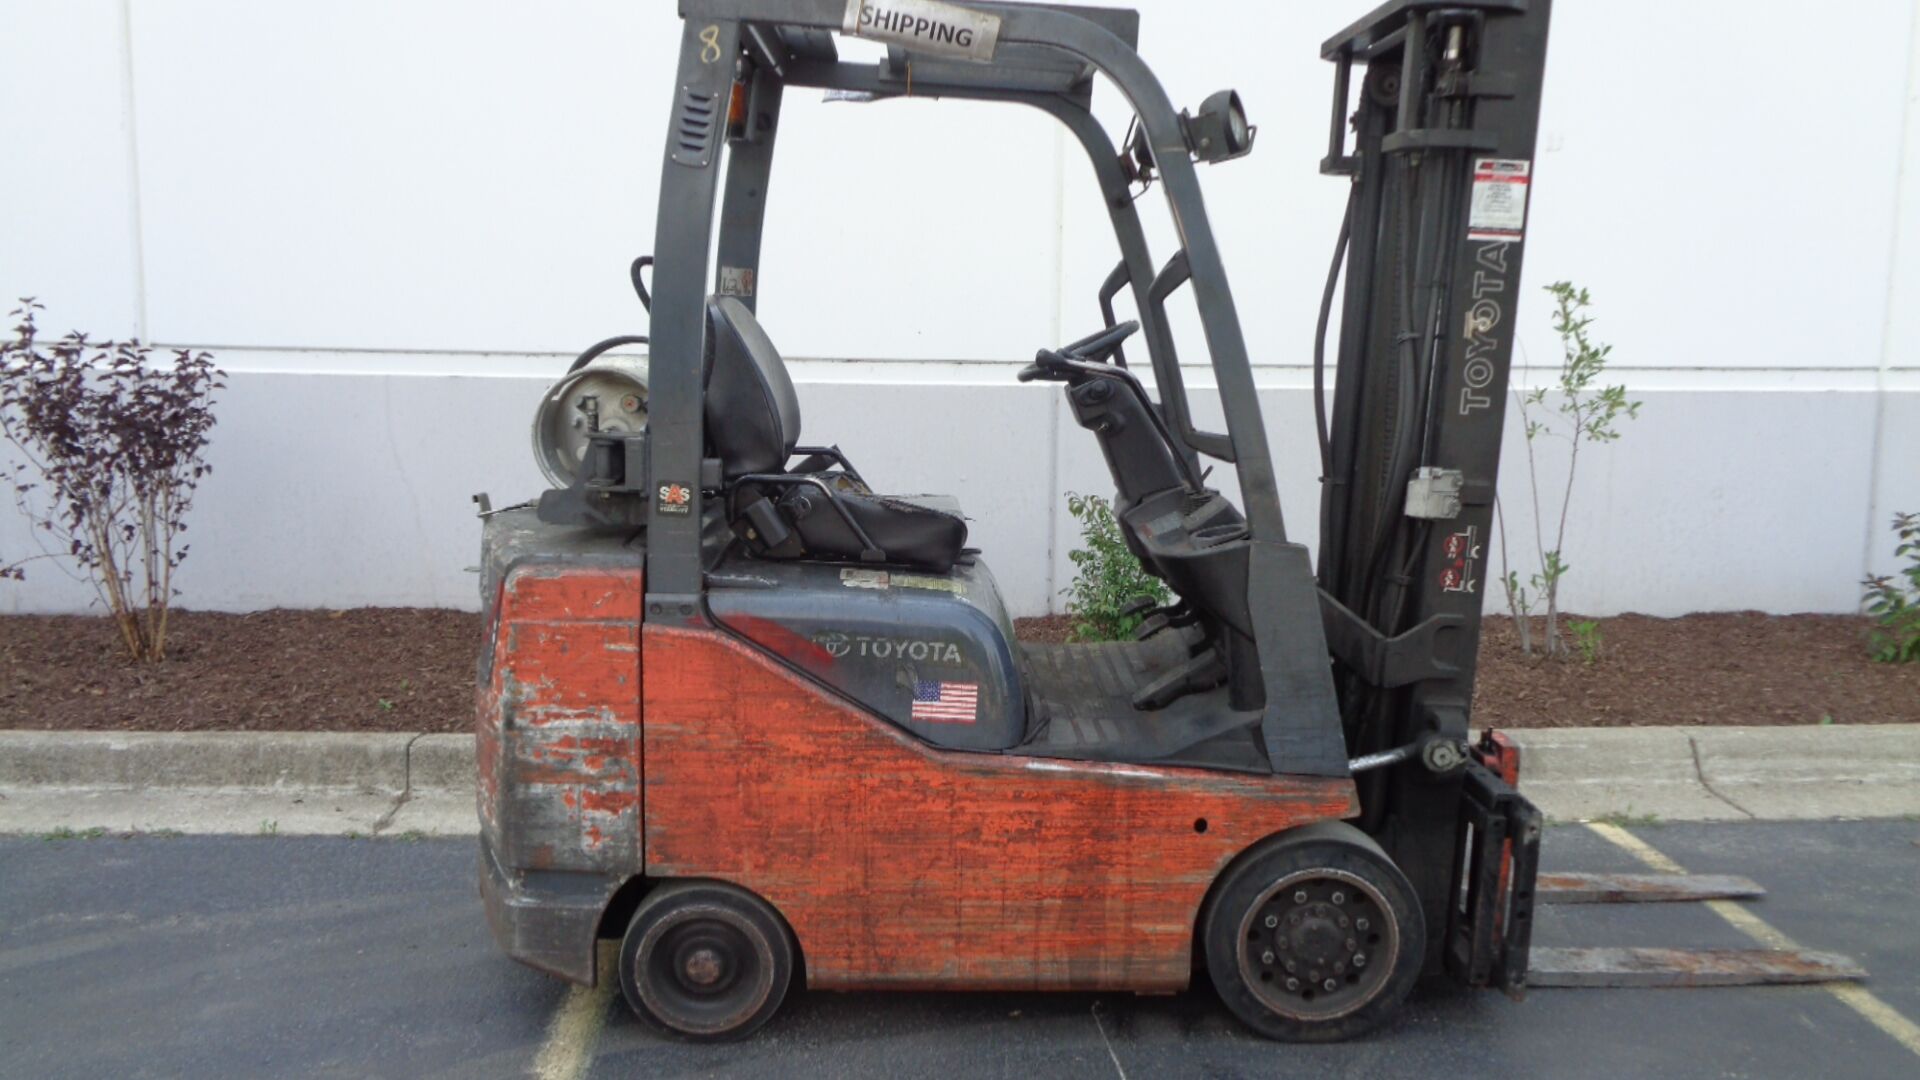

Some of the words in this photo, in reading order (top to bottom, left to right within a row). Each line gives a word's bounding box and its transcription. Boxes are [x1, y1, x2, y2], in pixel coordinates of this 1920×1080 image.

[699, 25, 721, 63] 8
[860, 5, 974, 48] SHIPPING
[1459, 241, 1510, 415] TOYOTA
[659, 484, 690, 504] SAS
[856, 636, 962, 663] TOYOTA
